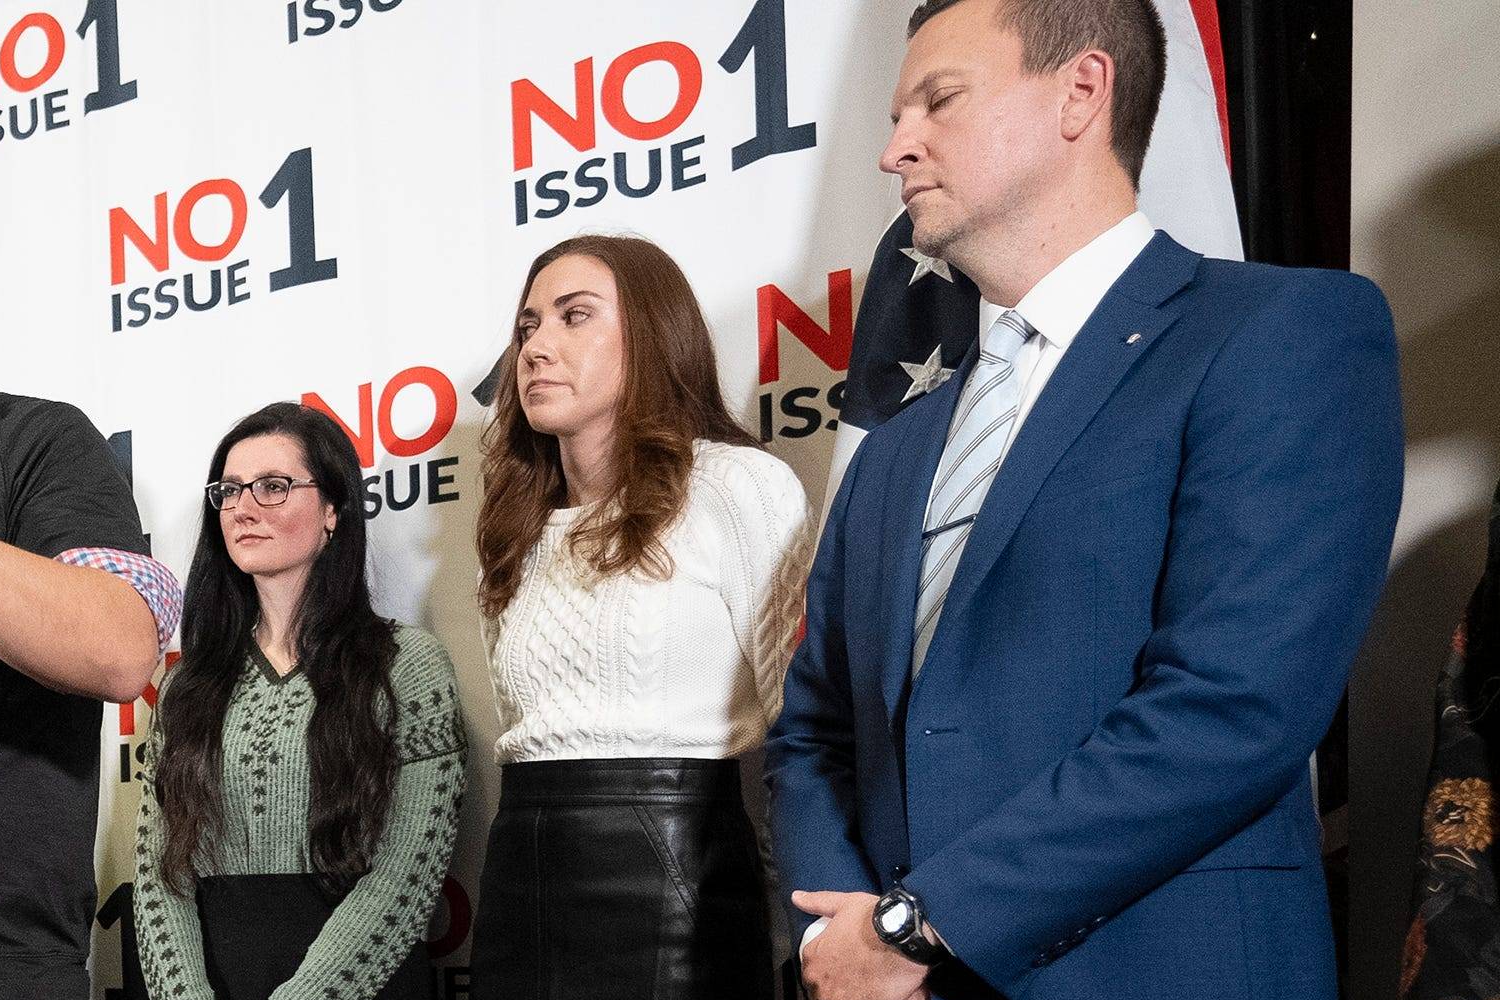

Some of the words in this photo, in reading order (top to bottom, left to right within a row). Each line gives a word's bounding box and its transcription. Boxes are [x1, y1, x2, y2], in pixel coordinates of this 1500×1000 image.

[76, 0, 138, 117] 1
[287, 0, 403, 44] ISS
[511, 40, 703, 171] NO
[717, 0, 817, 172] 1
[108, 178, 248, 284] NO
[259, 147, 338, 293] 1
[514, 135, 706, 226] ISSUE
[111, 259, 251, 333] ISSUE
[757, 268, 853, 385] N
[301, 366, 457, 468] NO
[363, 456, 460, 520] SUE
